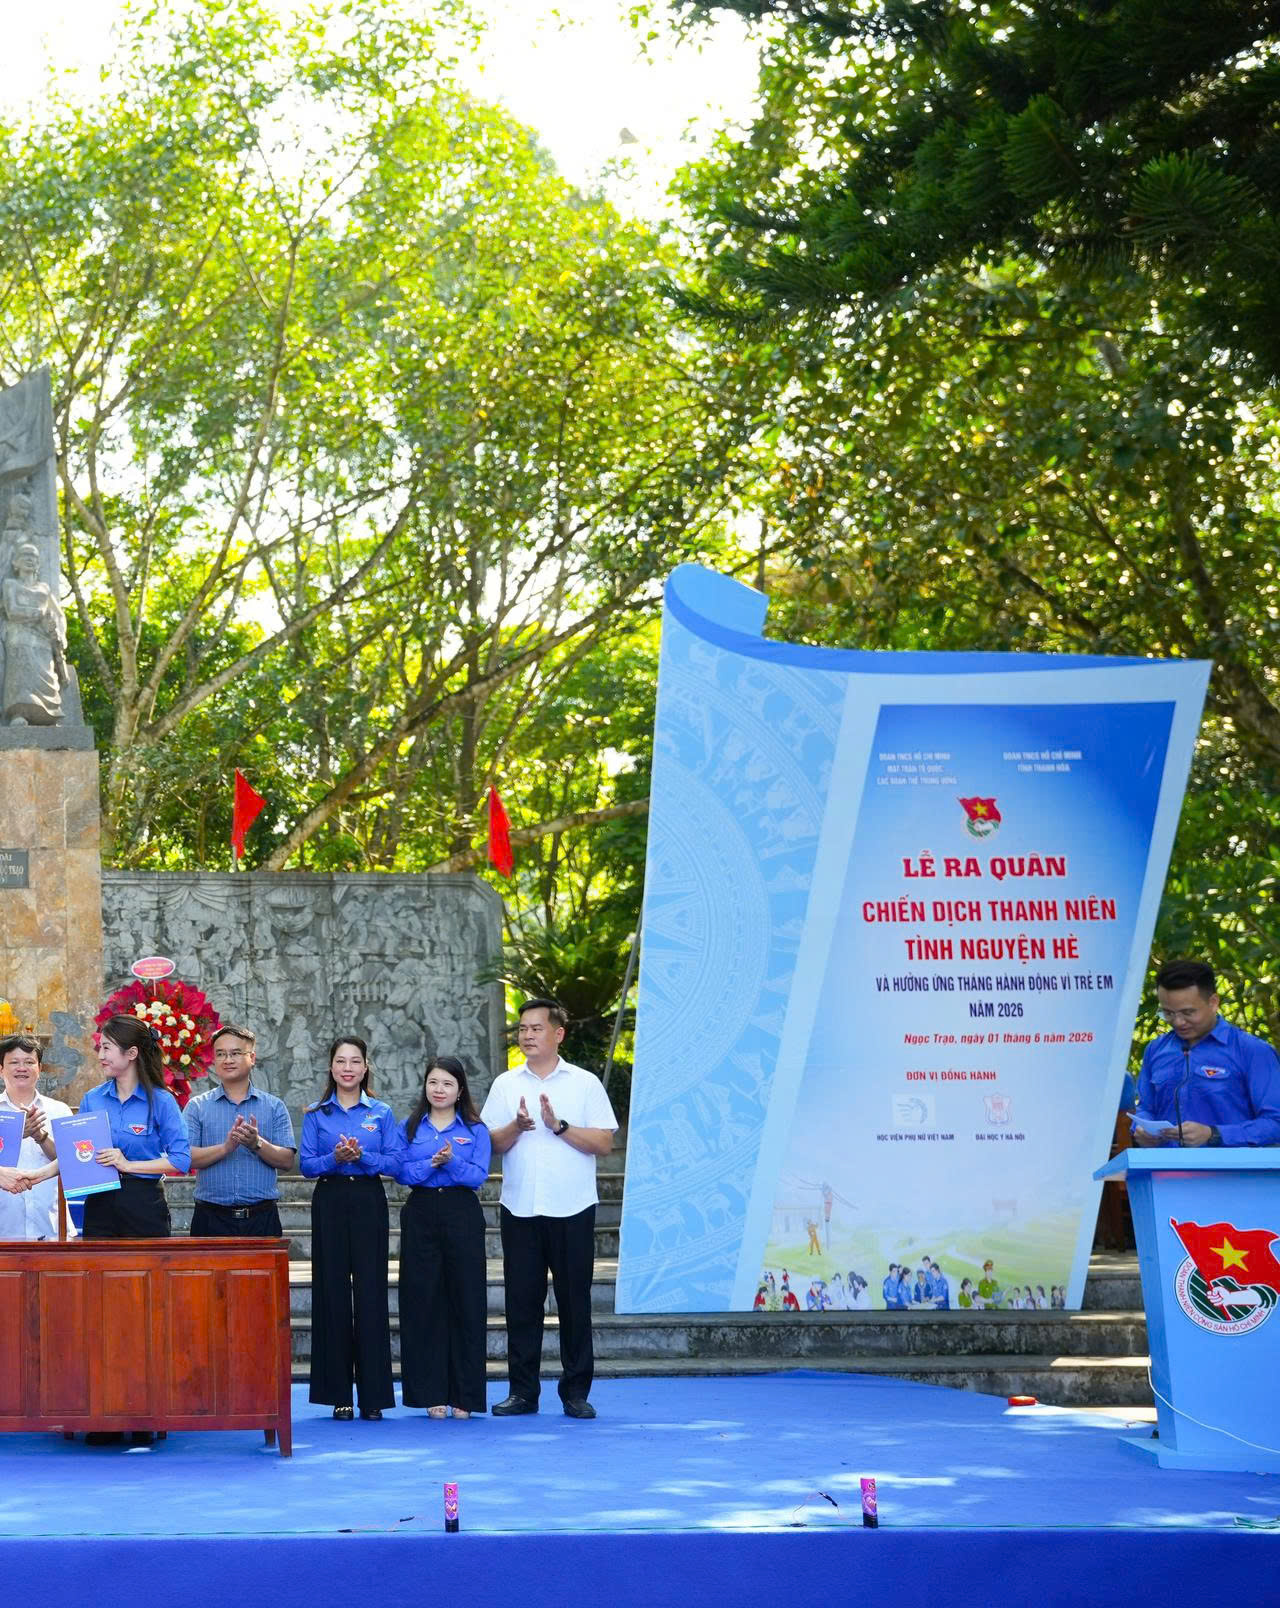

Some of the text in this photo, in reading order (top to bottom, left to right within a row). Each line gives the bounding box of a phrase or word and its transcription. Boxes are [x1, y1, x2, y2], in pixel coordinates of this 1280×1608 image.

[902, 850, 1066, 880] LỄ RA QUÂN
[863, 894, 1116, 926] CHIẾN DỊCH THANH NIÊN
[905, 934, 1079, 964] TÌNH NGUYỆN HÈ
[876, 974, 890, 992] VÀ
[957, 973, 992, 992] THÁNG
[996, 972, 1025, 990] HÀNH
[1029, 972, 1057, 994] ĐỘNG
[1061, 972, 1071, 990] VÌ
[1097, 975, 1113, 990] EM
[969, 1000, 1024, 1017] NĂM 2026
[904, 1034, 929, 1044] Ngọc
[961, 1033, 984, 1044] ngày
[988, 1033, 999, 1043] 01
[1034, 1033, 1040, 1042] 6
[1069, 1032, 1093, 1042] 2026
[906, 1071, 925, 1080] ĐƠN
[929, 1072, 937, 1082] VỊ
